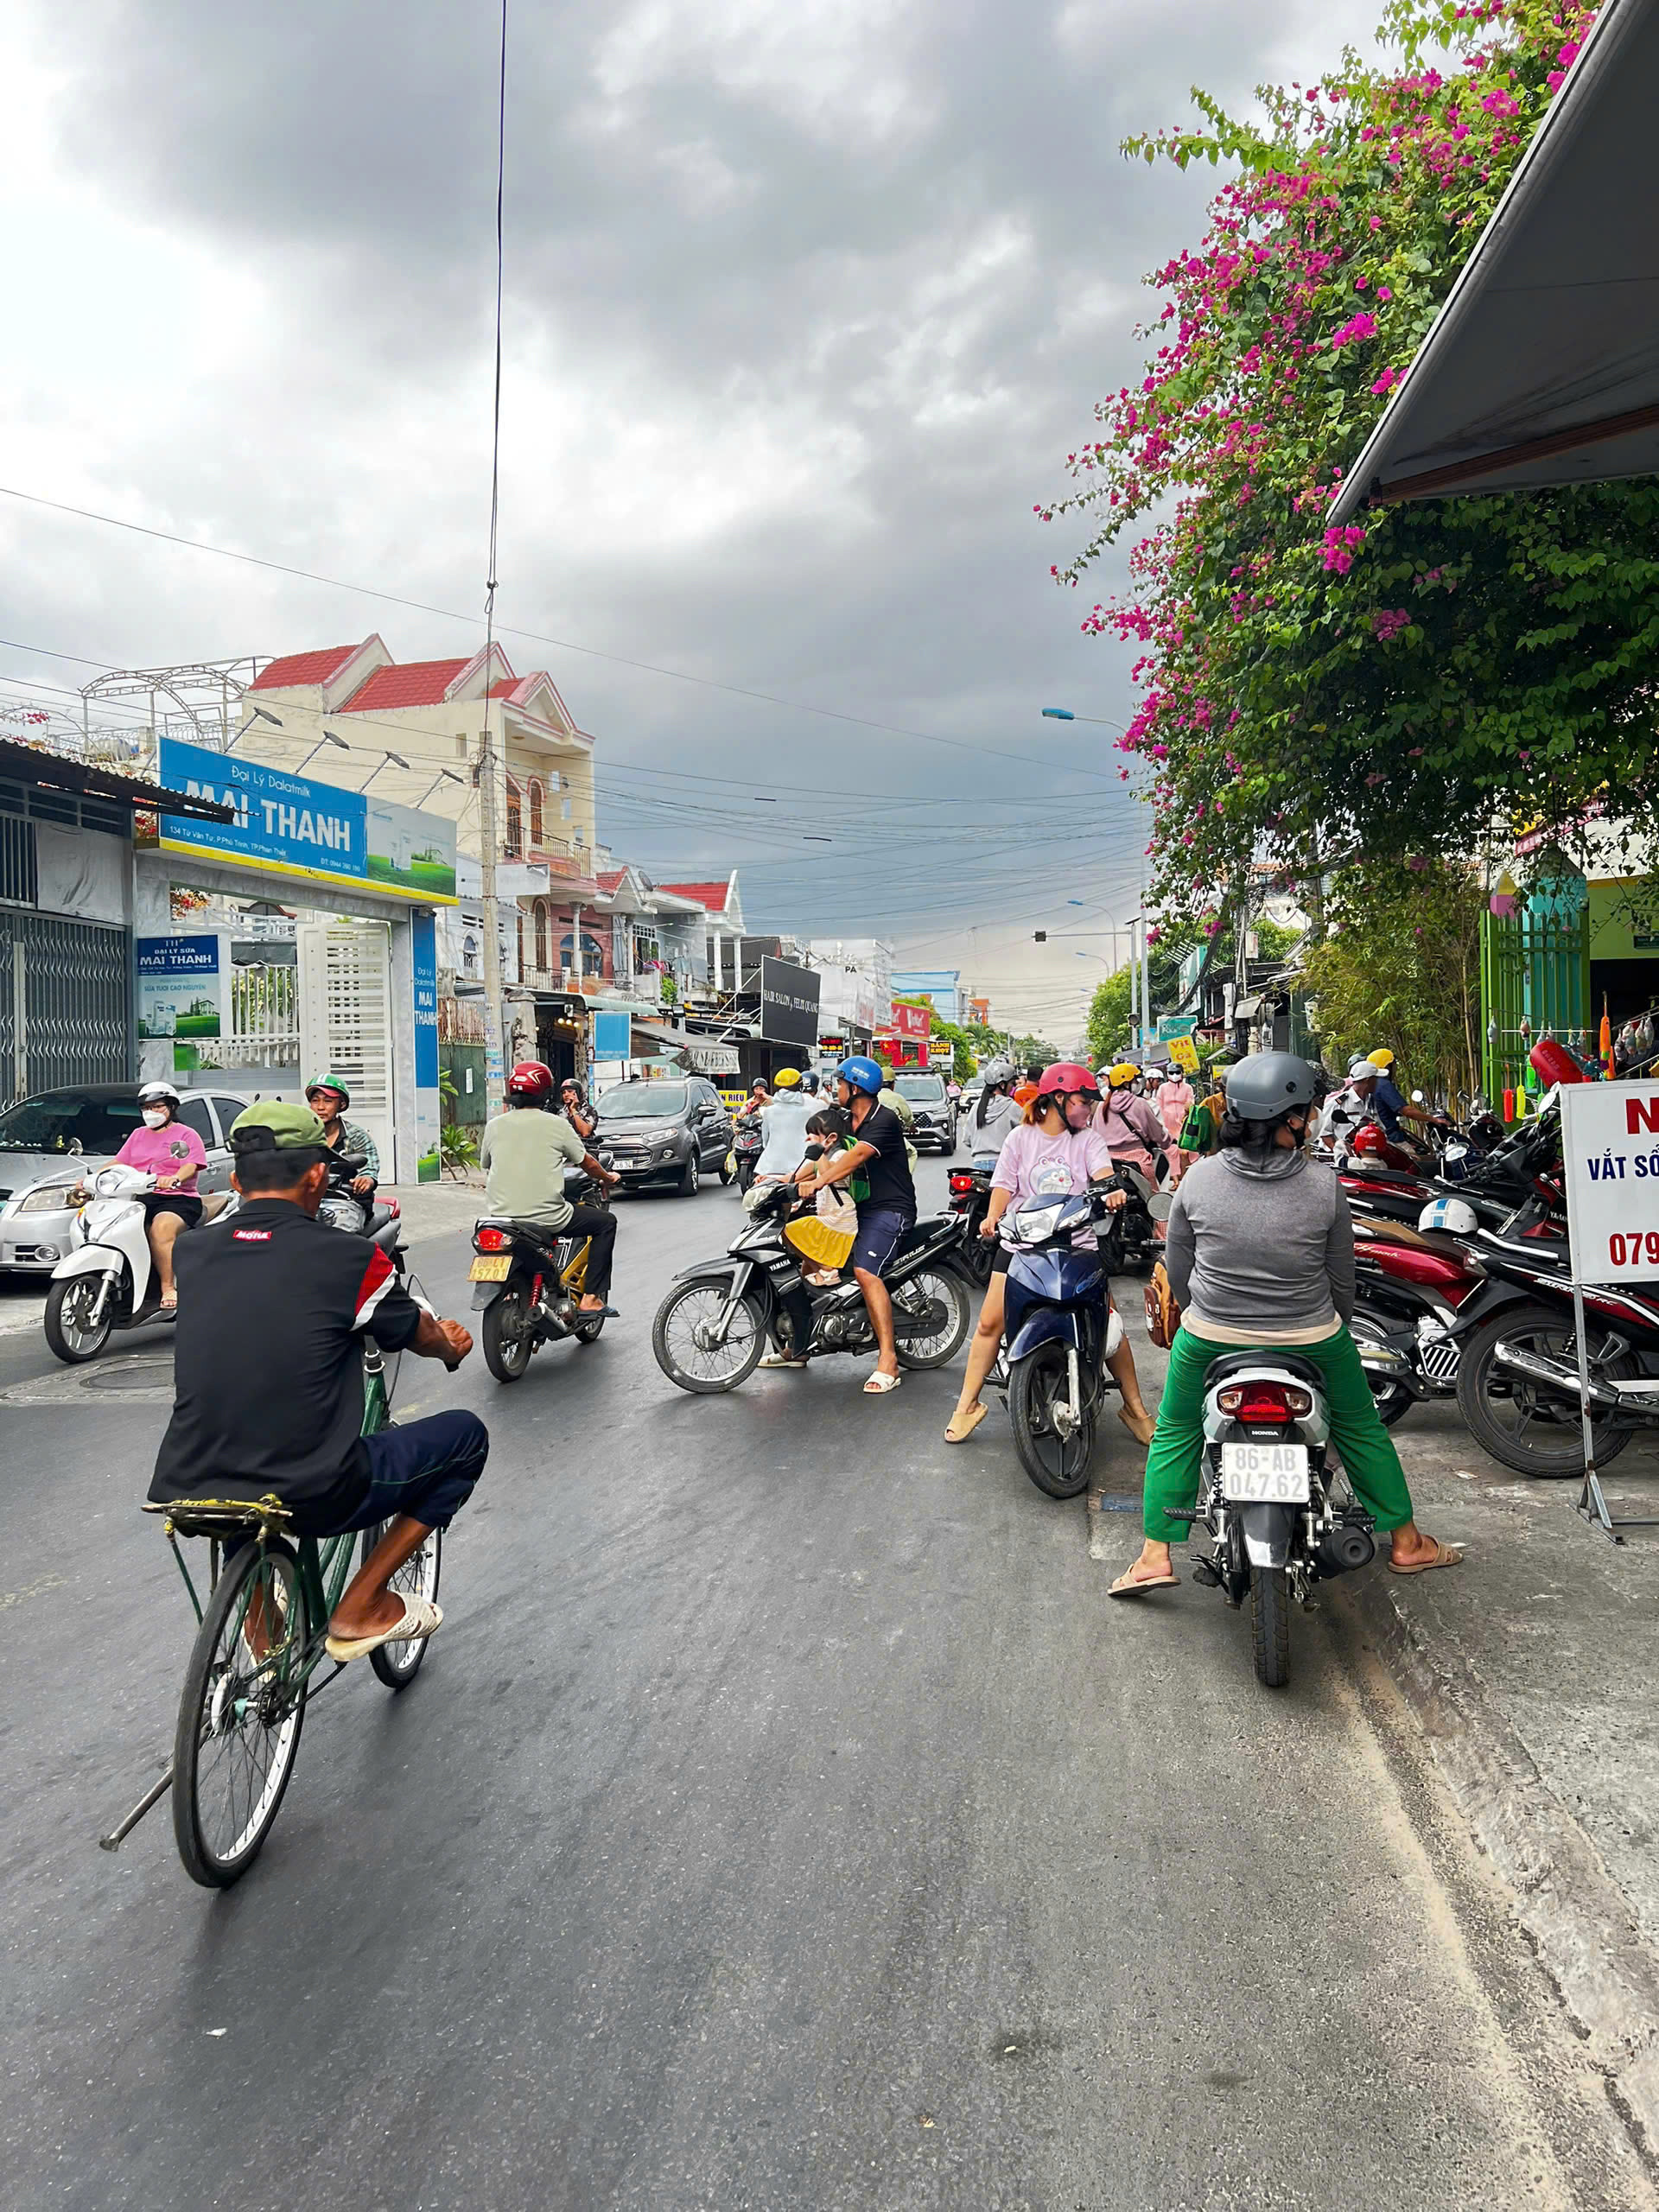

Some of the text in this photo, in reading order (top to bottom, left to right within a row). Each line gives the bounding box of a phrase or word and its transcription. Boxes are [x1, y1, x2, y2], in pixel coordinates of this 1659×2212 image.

[232, 766, 311, 798] Đại Lý Dalatmilk
[169, 825, 181, 835] 134
[261, 799, 350, 851] THANH
[139, 954, 212, 965] MAI THANH
[418, 991, 433, 1007] MAI
[763, 988, 775, 1002] HAIR
[775, 992, 791, 1007] SALON
[793, 996, 805, 1011] FELIX
[415, 1009, 437, 1026] THANH
[1587, 1147, 1626, 1180] VẮT
[1609, 1231, 1659, 1266] 079
[769, 1259, 791, 1272] YAMAHA
[1235, 1447, 1296, 1471] 86-AB
[1230, 1472, 1304, 1498] 047.62
